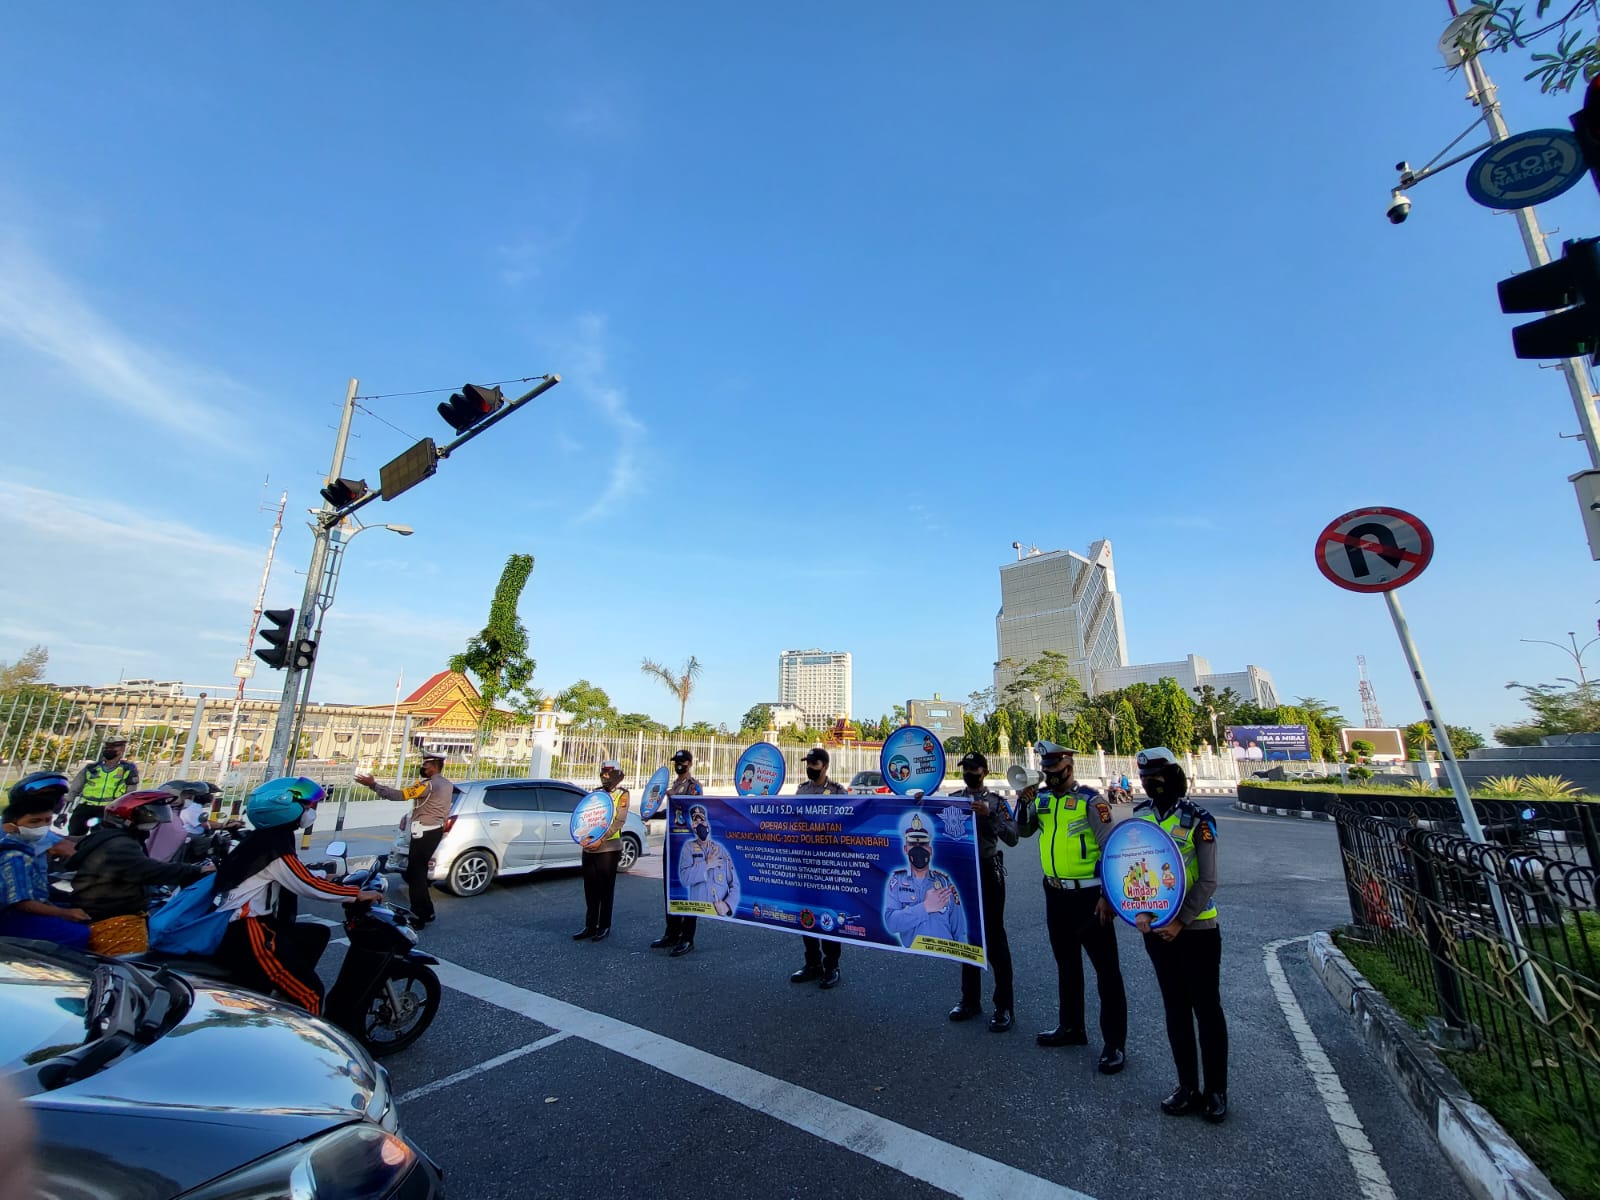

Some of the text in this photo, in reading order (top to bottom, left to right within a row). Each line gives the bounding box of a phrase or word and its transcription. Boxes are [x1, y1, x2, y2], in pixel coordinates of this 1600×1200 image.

[1494, 148, 1558, 180] STOP
[1494, 160, 1563, 186] NARKOBA
[750, 804, 774, 814] MULAI
[780, 805, 794, 814] S.D.
[796, 806, 803, 814] 14
[805, 805, 834, 815] MARET
[834, 806, 854, 816] 2022
[760, 821, 842, 832] OPERASI KESELAMATAN
[801, 834, 838, 844] POLRESTA
[840, 836, 889, 847] PEKANBARU
[841, 852, 880, 860] KUNING-2022
[840, 885, 868, 894] COVID-19
[1121, 900, 1169, 910] Kerumunan
